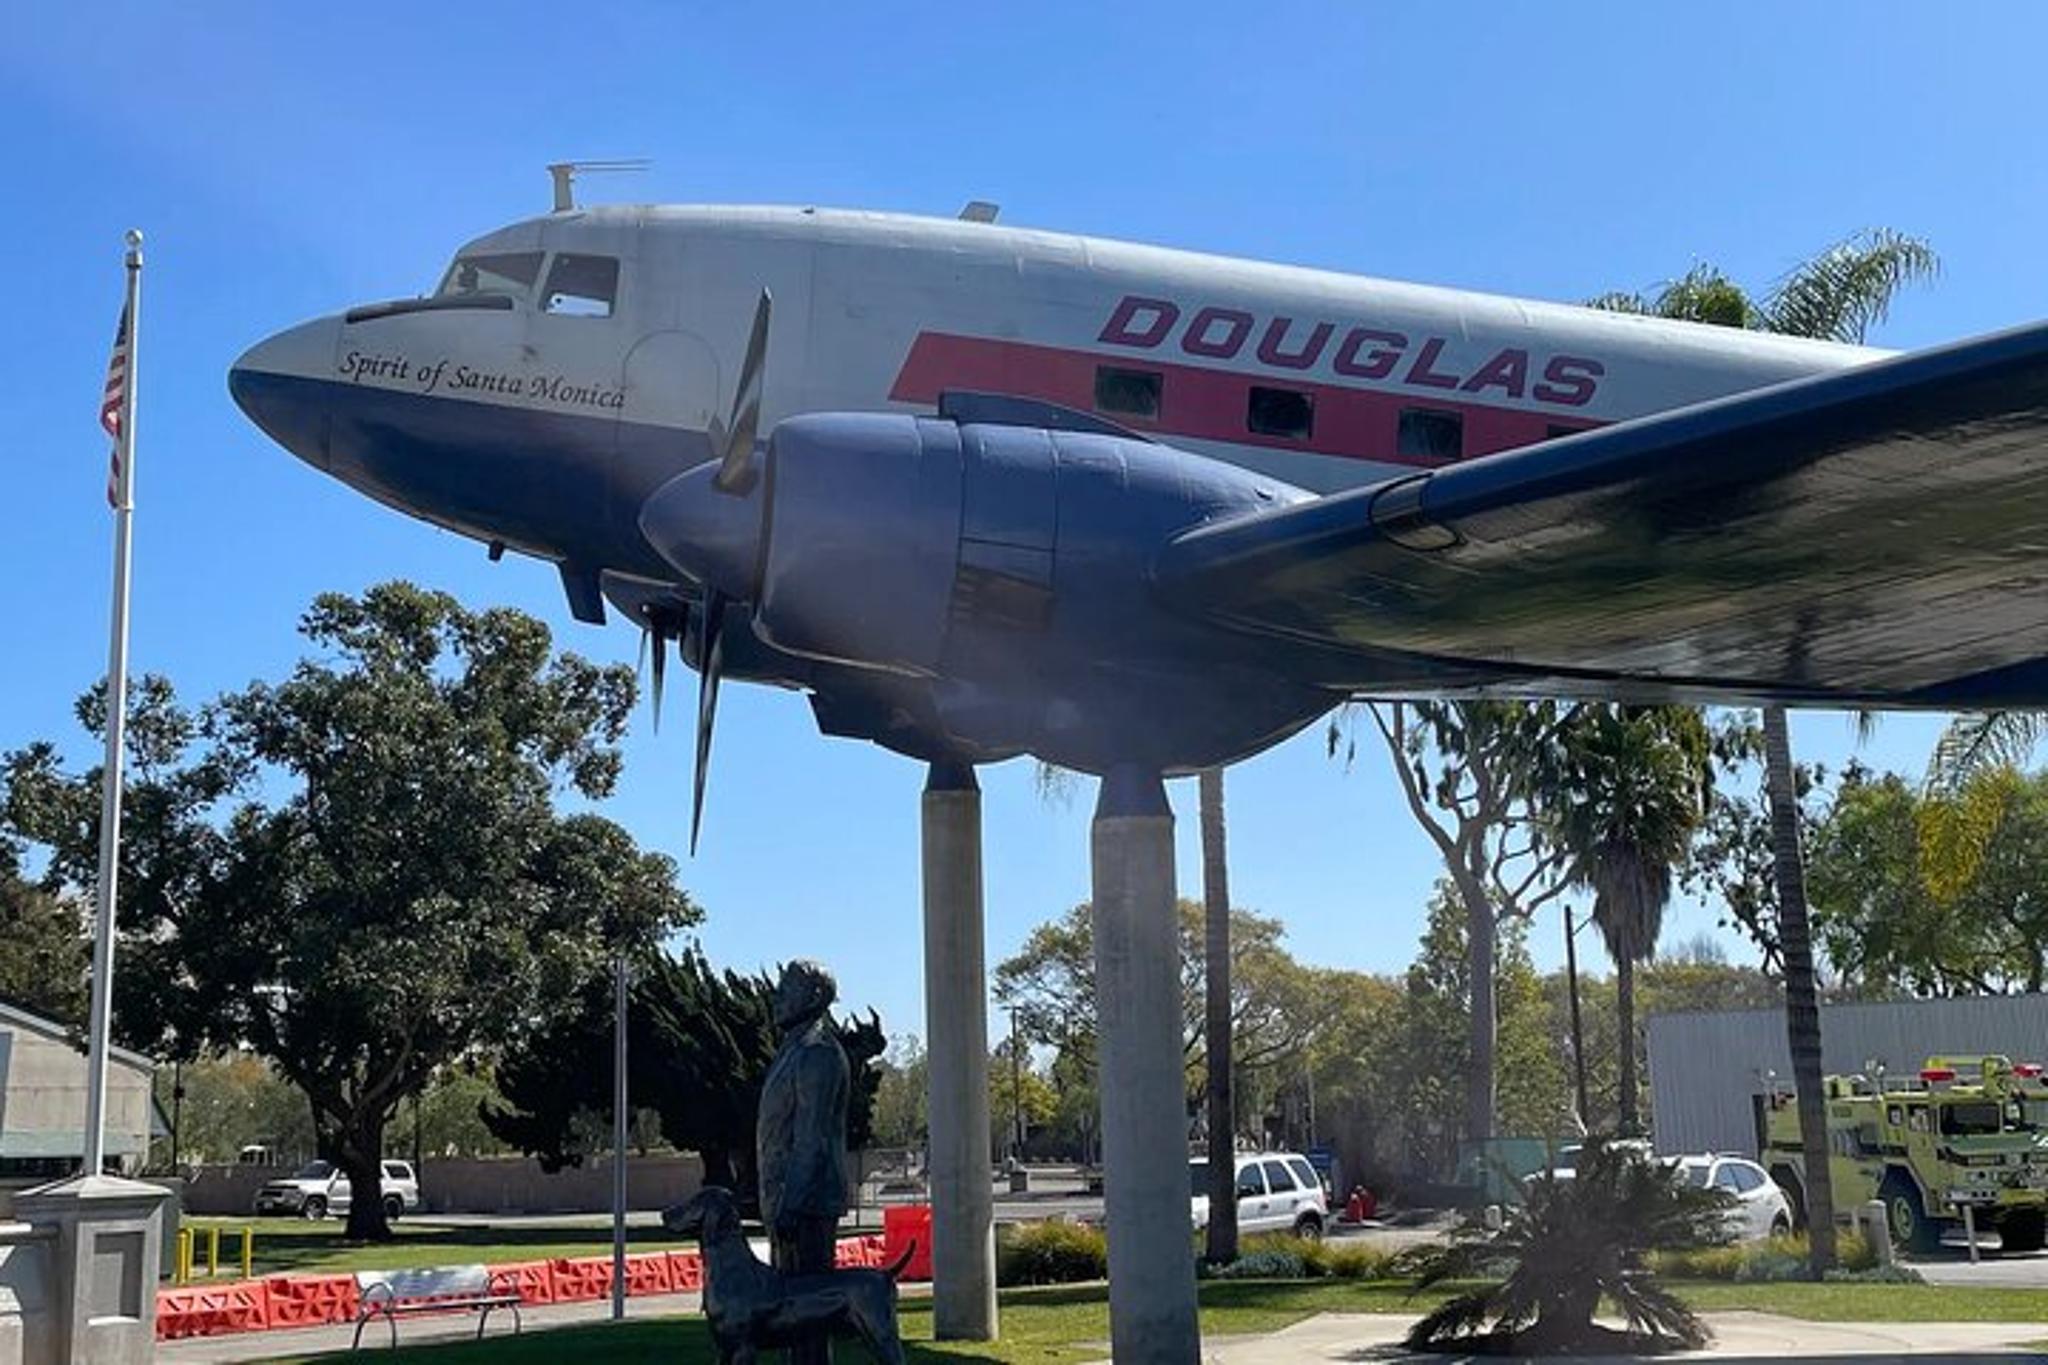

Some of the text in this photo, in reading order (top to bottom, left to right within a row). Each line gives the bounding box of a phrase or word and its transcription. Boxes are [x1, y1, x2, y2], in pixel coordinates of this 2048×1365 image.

[339, 351, 625, 408] Spirit of Santa Monica
[1097, 295, 1604, 407] DOUGLAS
